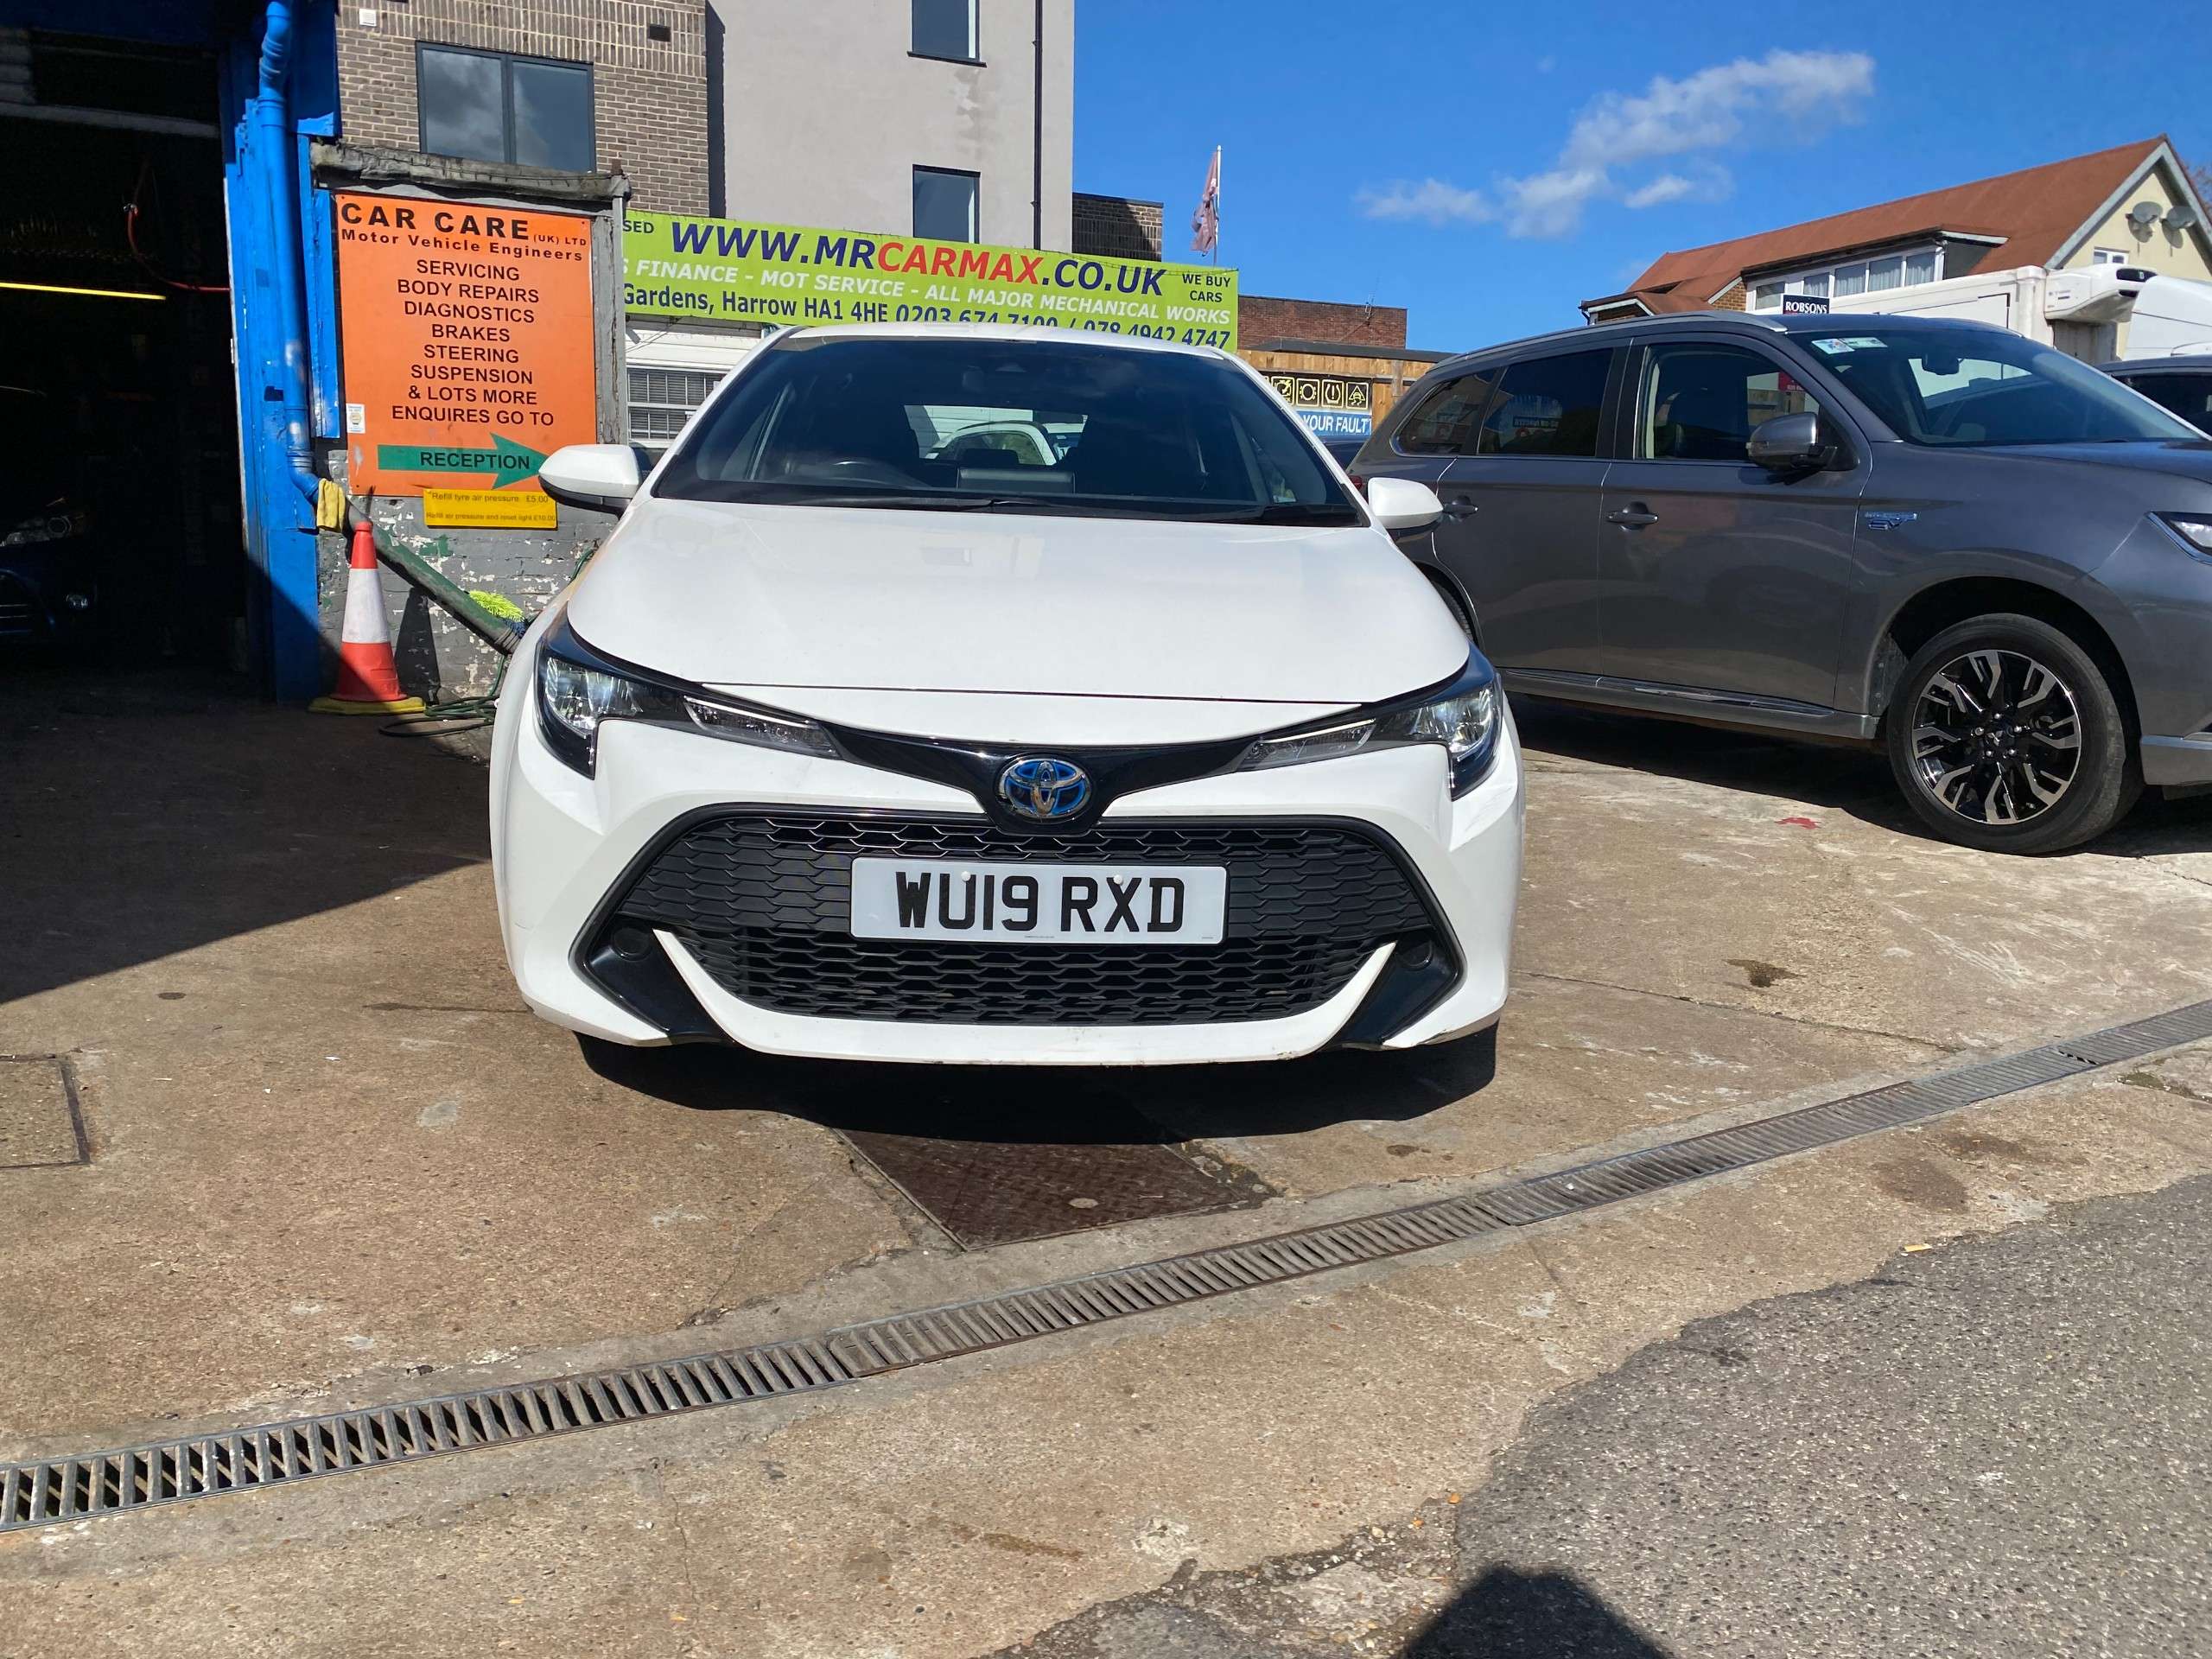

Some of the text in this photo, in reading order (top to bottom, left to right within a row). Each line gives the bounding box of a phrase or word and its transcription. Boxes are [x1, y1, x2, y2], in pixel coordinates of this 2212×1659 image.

[341, 203, 587, 246] CAR CARE (UK) LTD
[342, 229, 582, 261] Motor Vehicle Engineers
[671, 221, 1166, 296] WWW.MRCARMAX.CO.UK
[416, 259, 520, 281] SERVICING
[1182, 274, 1231, 288] WE BUY
[397, 280, 539, 303] BODY REPAIRS
[636, 259, 739, 283] FINANCE
[760, 270, 810, 289] MOT
[814, 274, 906, 297] SERVICE
[925, 284, 961, 302] ALL
[968, 289, 1034, 308] MAJOR
[1039, 295, 1160, 320] MECHANICAL
[1166, 305, 1231, 324] WORKS
[1189, 290, 1223, 302] CARS
[404, 301, 535, 323] DIAGNOSTICS
[623, 283, 715, 315] Gardens,
[722, 290, 797, 317] Harrow
[804, 297, 843, 320] HA1
[850, 302, 888, 322] 4HE
[1182, 328, 1230, 349] 4747
[1785, 301, 1827, 315] ROBSONS
[432, 324, 510, 342] BRAKES
[424, 345, 519, 364] STEERING
[411, 365, 533, 385] SUSPENSION
[409, 385, 537, 404] & LOTS MORE
[392, 405, 554, 426] ENQUIRES GO TO
[1303, 415, 1333, 431] YOUR
[421, 452, 531, 469] RECEPTION
[454, 493, 470, 502] tyre
[895, 871, 1185, 932] WU19 RXD
